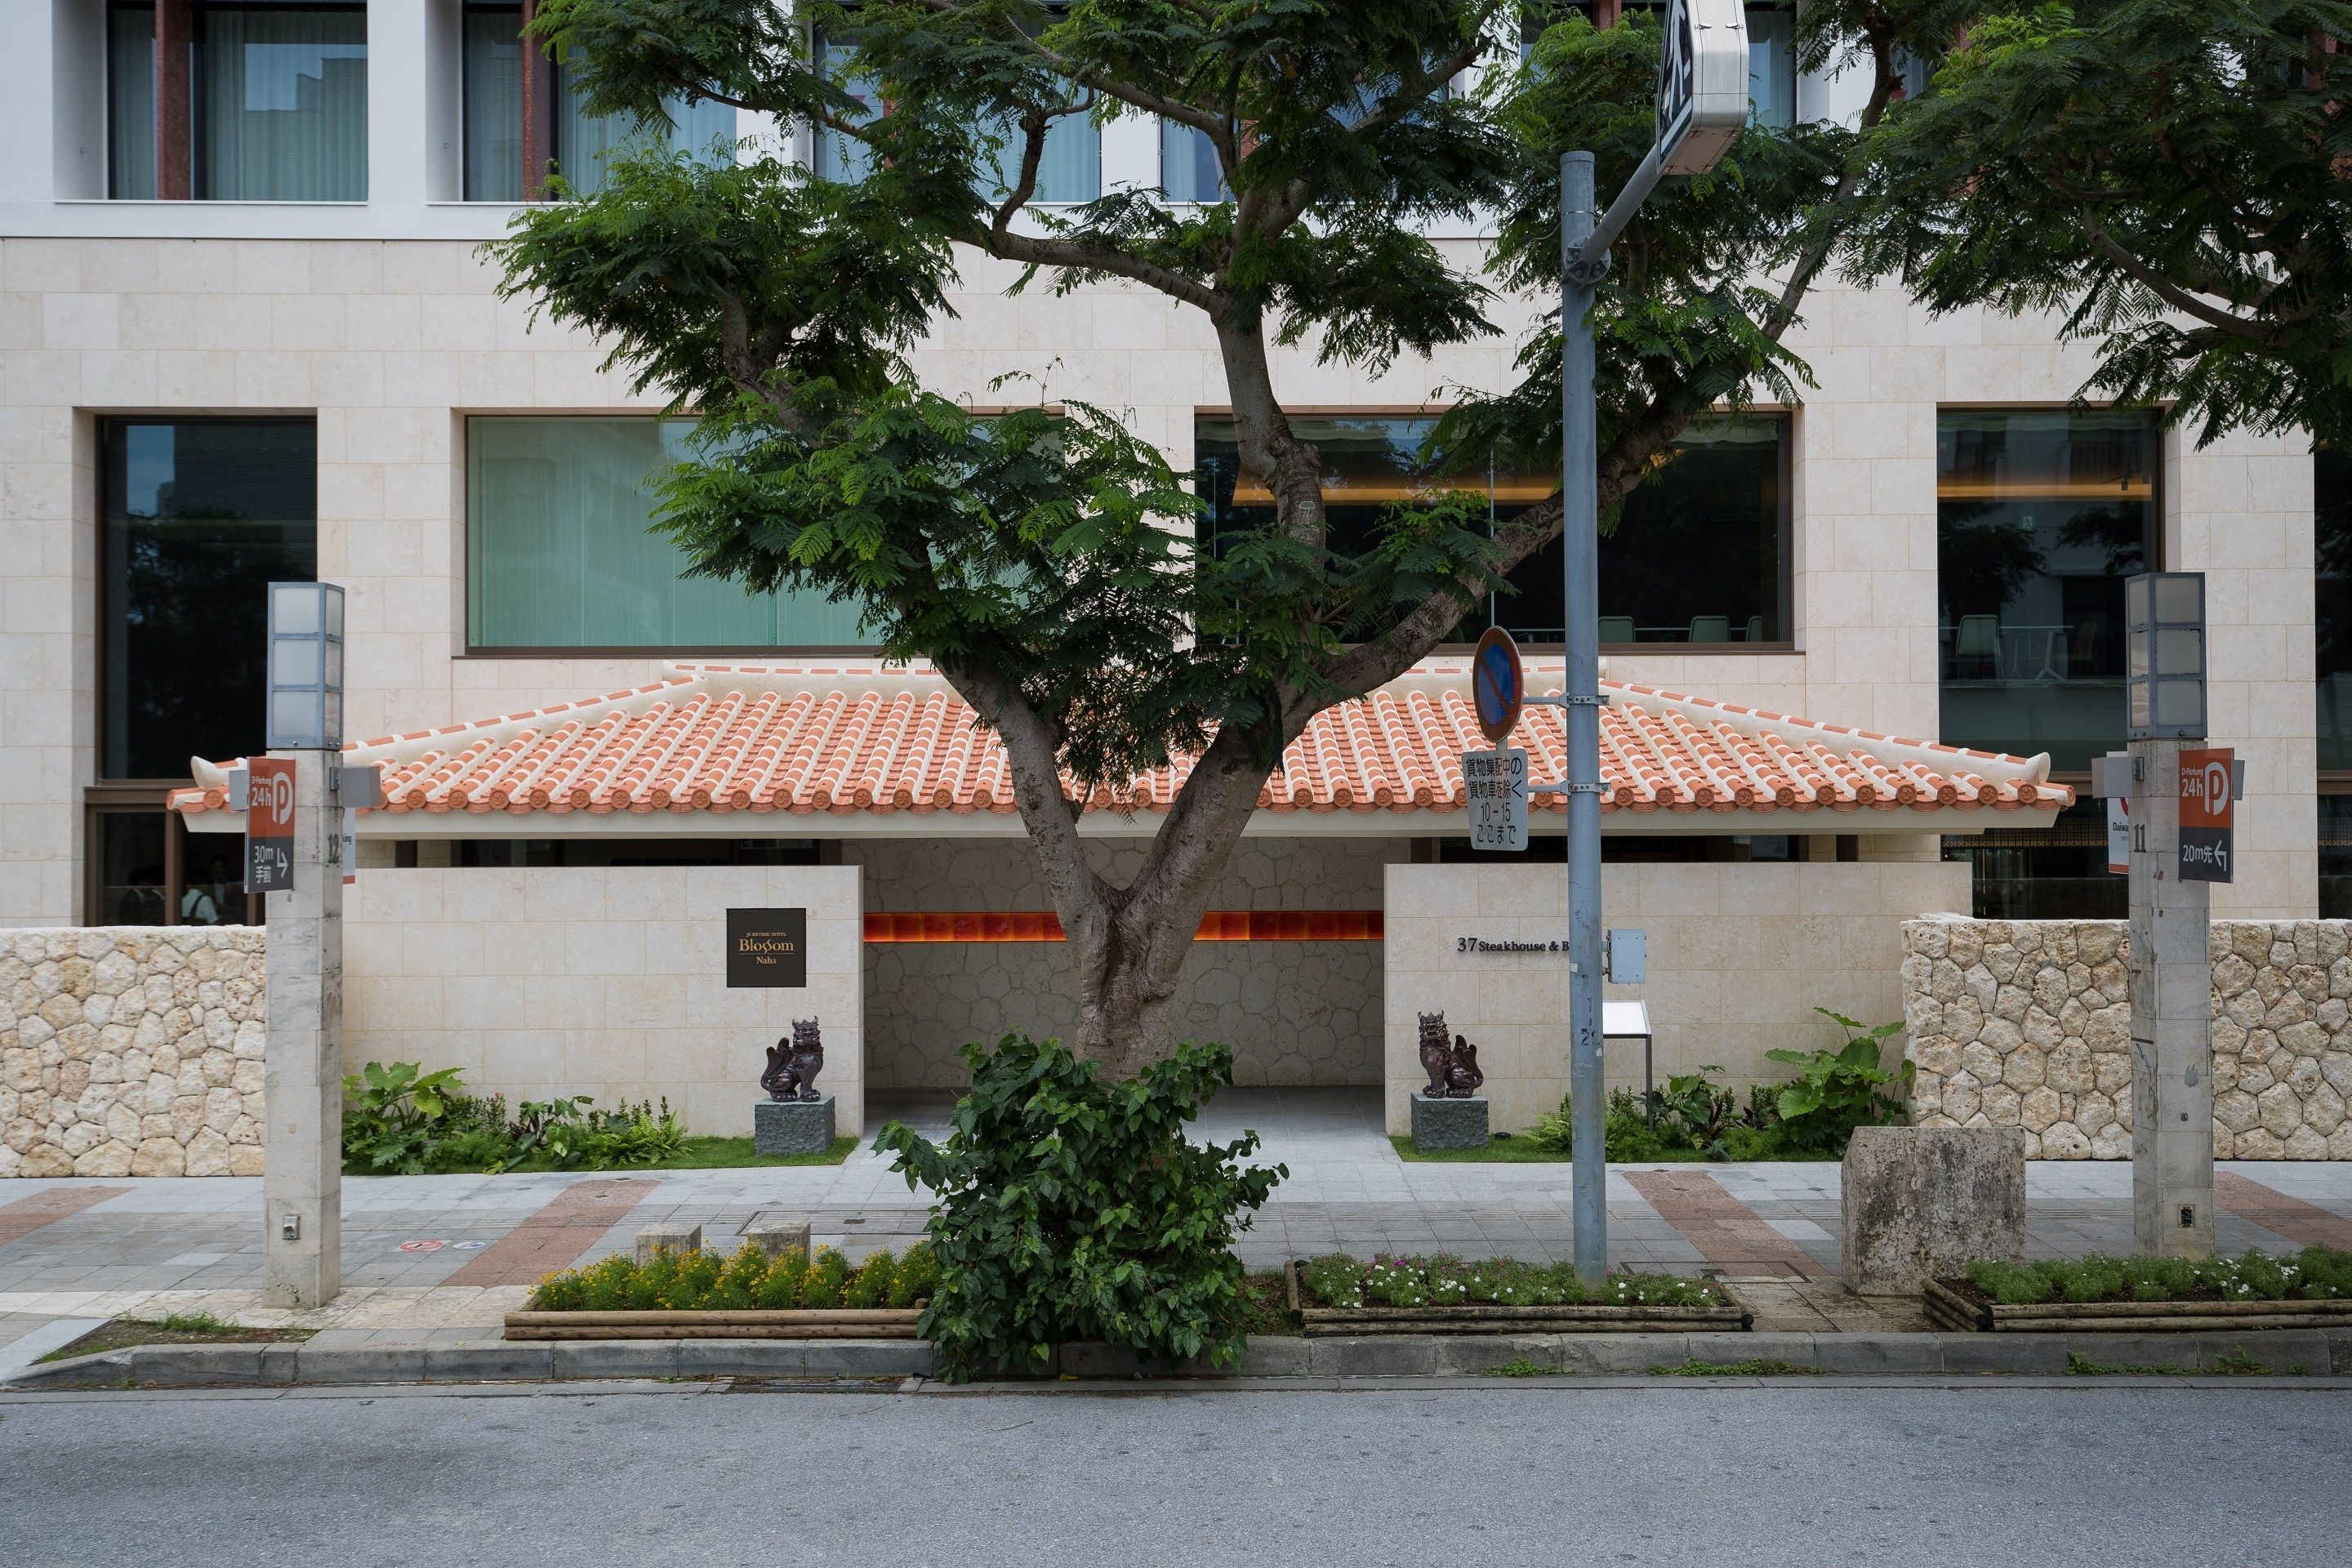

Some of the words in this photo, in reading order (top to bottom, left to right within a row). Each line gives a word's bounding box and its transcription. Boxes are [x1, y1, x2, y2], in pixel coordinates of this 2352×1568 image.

[1466, 756, 1522, 777] 貨物集配中の
[252, 786, 271, 807] 24h
[1468, 780, 1522, 799] 貨物車を除く
[2181, 778, 2203, 797] 24h
[1477, 824, 1517, 844] ここまで
[254, 845, 274, 863] 30m
[255, 865, 271, 884] 手前
[738, 938, 794, 955] Blossom
[1457, 938, 1477, 951] 37
[1478, 941, 1546, 951] Steakhouse
[1548, 942, 1558, 951] &
[1561, 941, 1570, 951] B
[755, 956, 777, 964] Naha
